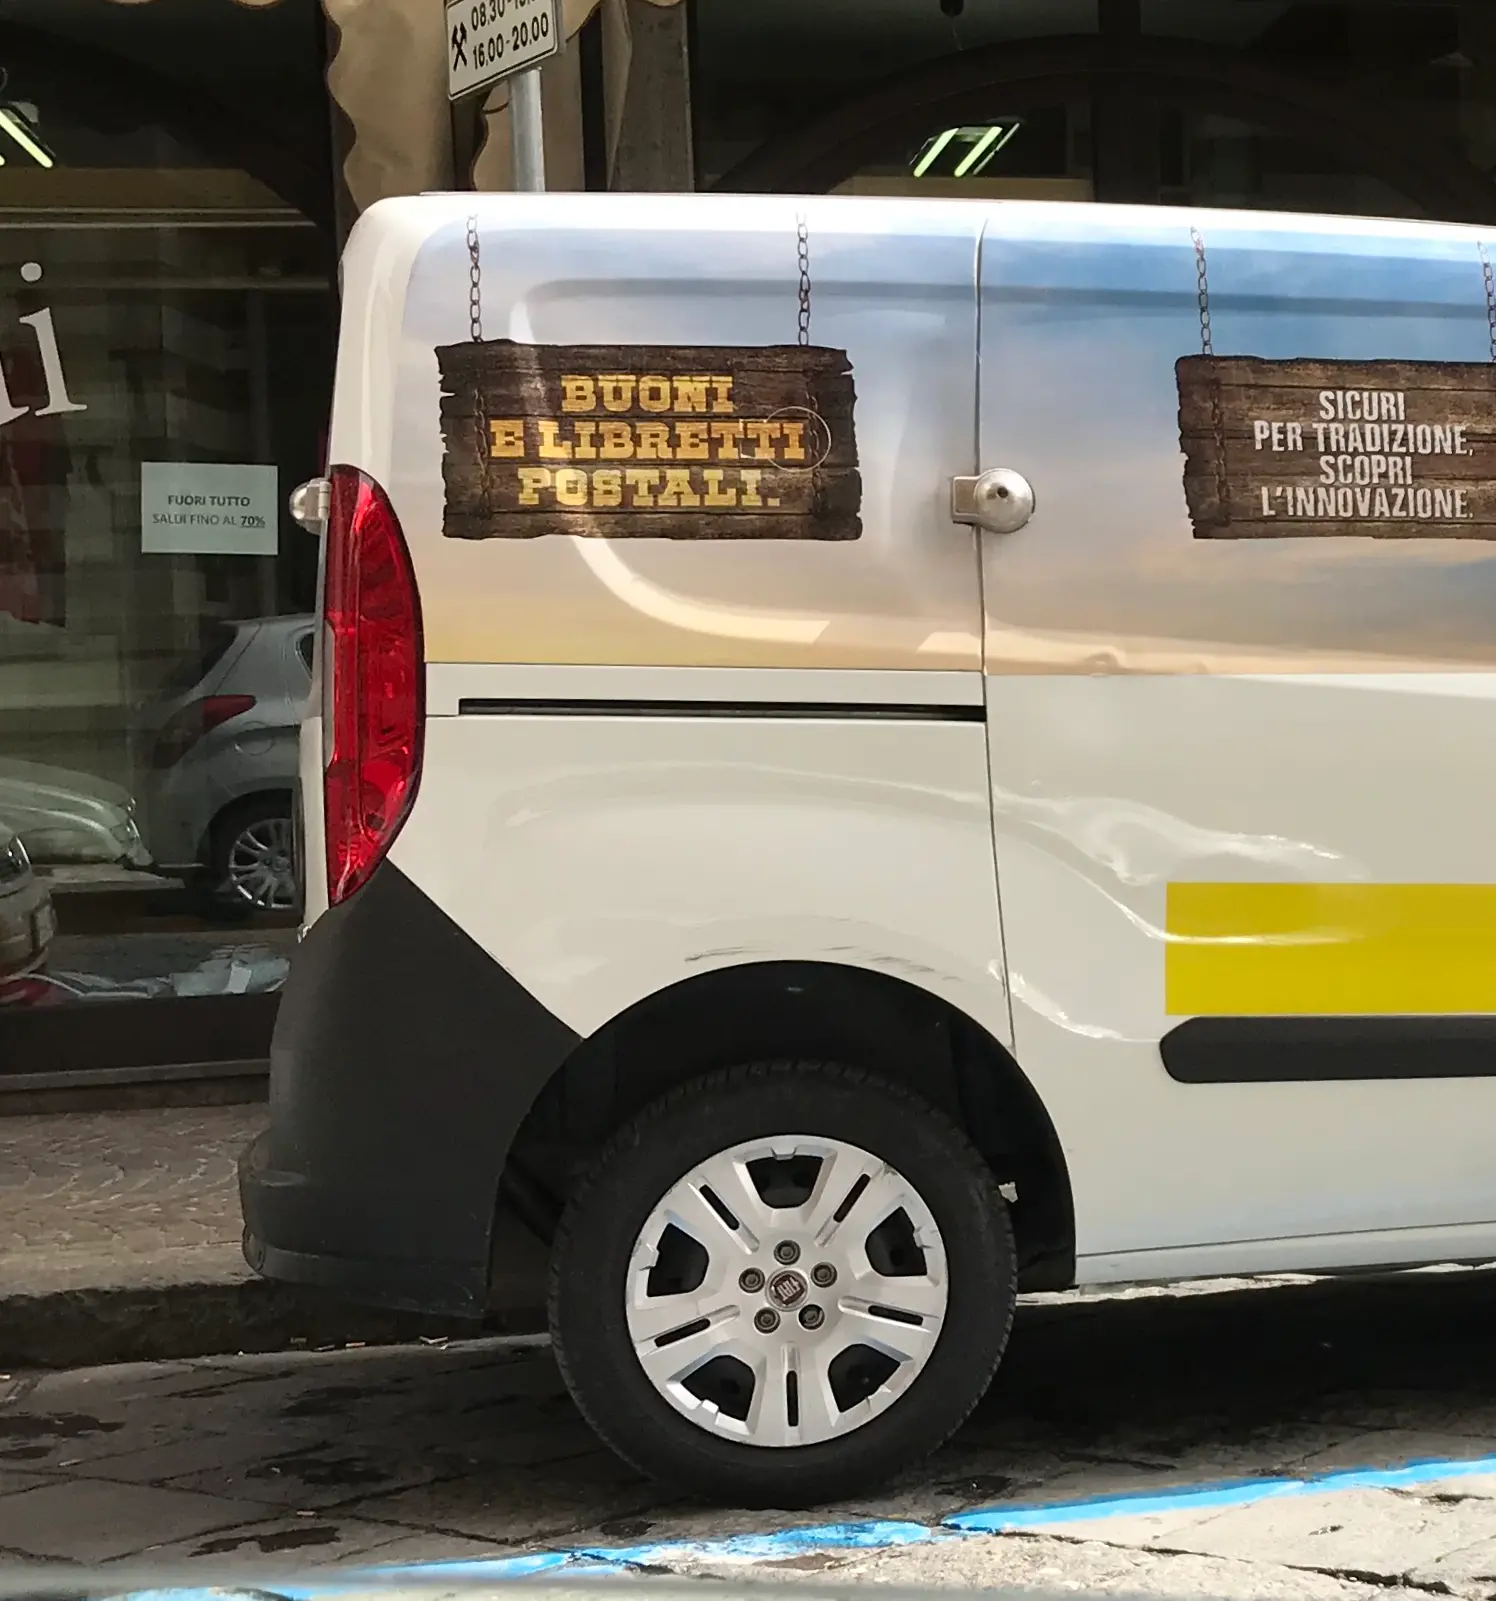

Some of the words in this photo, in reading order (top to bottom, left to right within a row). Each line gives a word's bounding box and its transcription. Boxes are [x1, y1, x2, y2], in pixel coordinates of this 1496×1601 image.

[560, 374, 734, 413] BUONI
[1318, 390, 1406, 421] SICURI
[489, 419, 525, 458] E
[537, 419, 806, 460] LIBRETTI
[1253, 420, 1303, 452] PER
[1312, 422, 1475, 456] TRADIZIONE,
[516, 466, 781, 507] POSTALI.
[1318, 454, 1413, 486] SCOPRI
[167, 494, 206, 506] FUORI
[208, 495, 251, 507] TUTTO
[1260, 486, 1474, 519] L'INNOVAZIONE.
[152, 513, 187, 525] SALDI
[189, 514, 220, 526] FINO
[222, 515, 237, 526] AL
[240, 515, 266, 528] 70%
